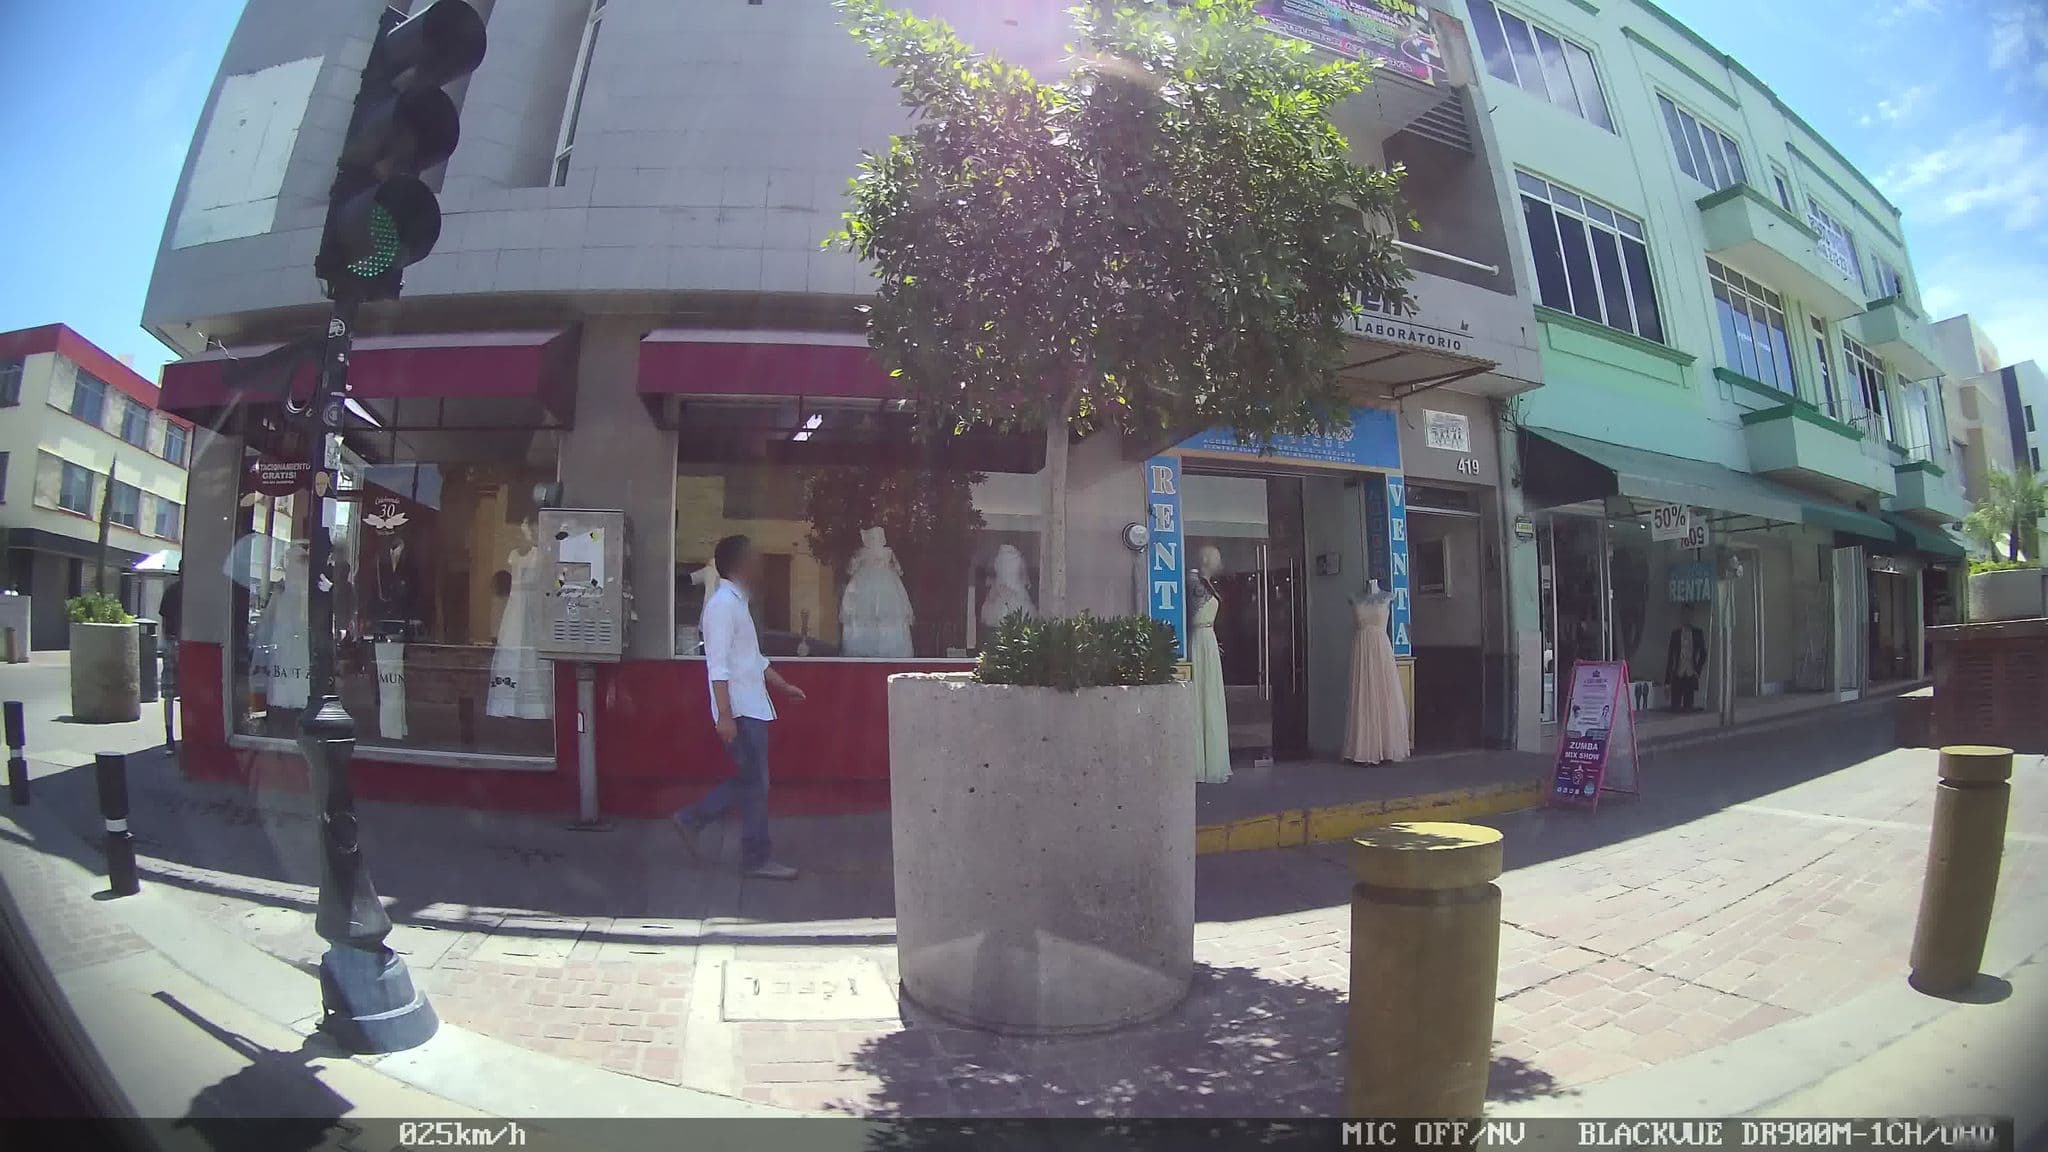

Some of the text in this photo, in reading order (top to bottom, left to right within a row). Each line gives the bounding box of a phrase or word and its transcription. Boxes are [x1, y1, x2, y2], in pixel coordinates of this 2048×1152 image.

[1355, 317, 1461, 350] LABORATORIO
[1457, 458, 1479, 475] 419
[262, 472, 297, 480] GRATIS!
[379, 503, 395, 518] 30
[1655, 505, 1686, 529] 50%
[1151, 465, 1179, 612] RENT
[1389, 484, 1409, 646] VENTA
[1569, 741, 1599, 751] ZUMBA
[1564, 751, 1600, 761] MIX SHOW
